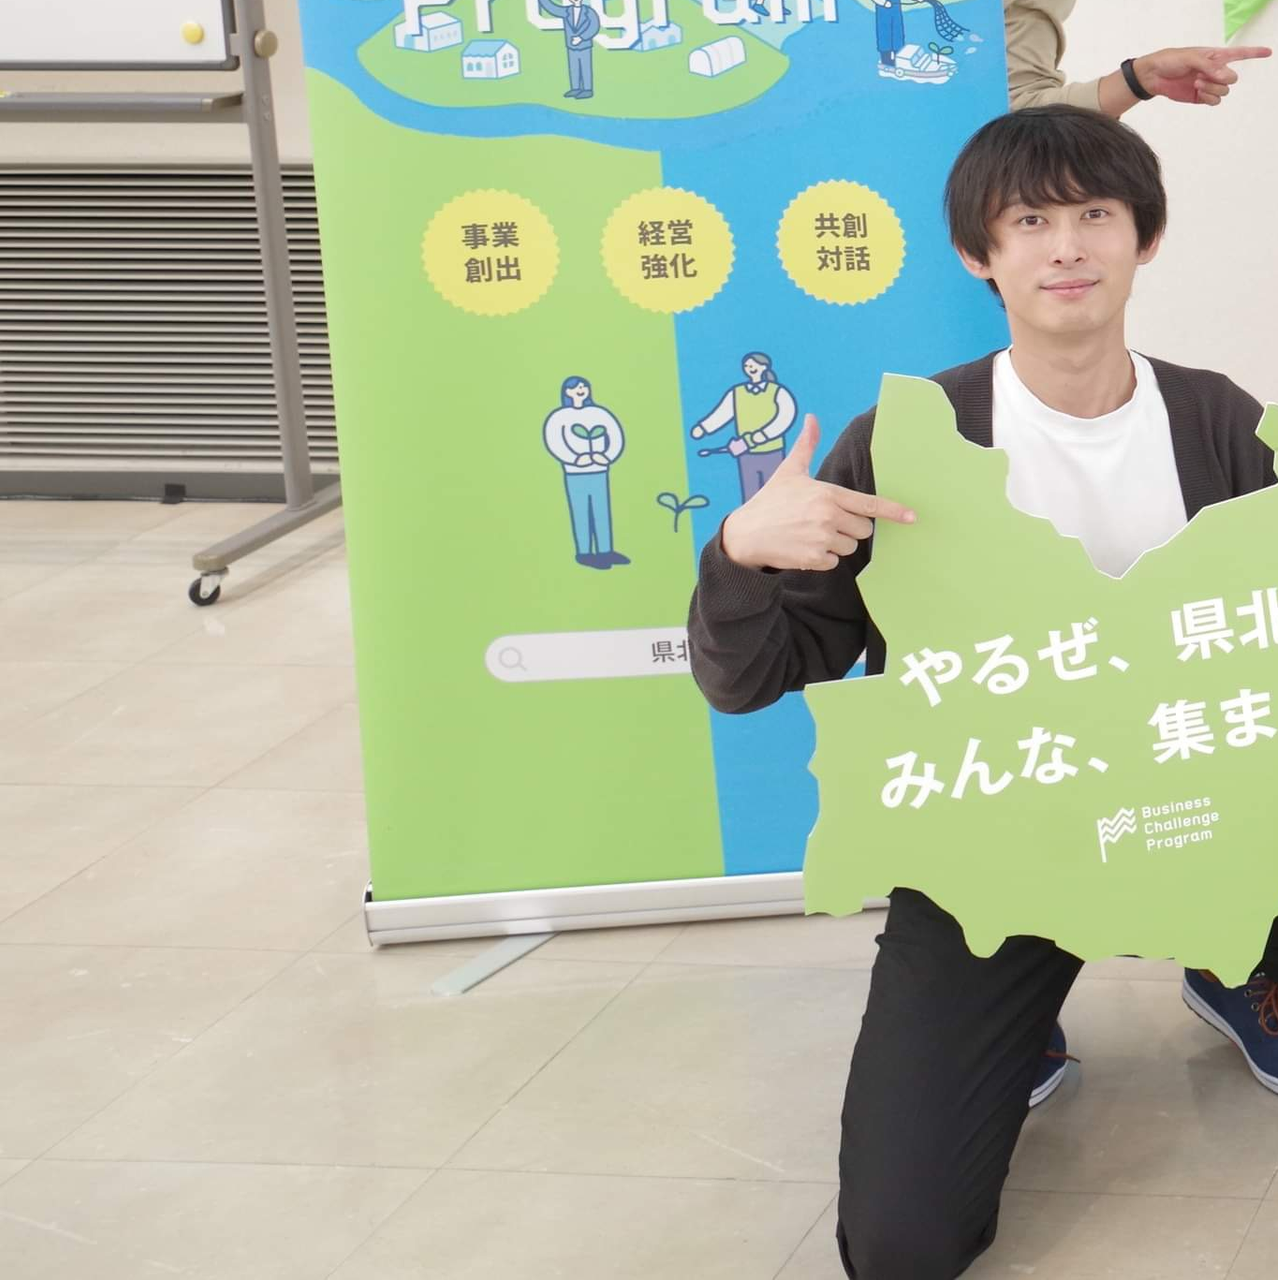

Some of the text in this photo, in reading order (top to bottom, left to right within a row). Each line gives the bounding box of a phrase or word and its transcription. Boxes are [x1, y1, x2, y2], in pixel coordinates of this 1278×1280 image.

[461, 221, 520, 251] 事業
[638, 218, 694, 248] 経営
[814, 212, 869, 241] 共創
[464, 255, 522, 284] 創出
[641, 252, 698, 280] 強化
[816, 245, 871, 273] 対話
[1141, 795, 1212, 819] Business
[1144, 809, 1220, 835] Challenge
[1146, 828, 1214, 852] Program
